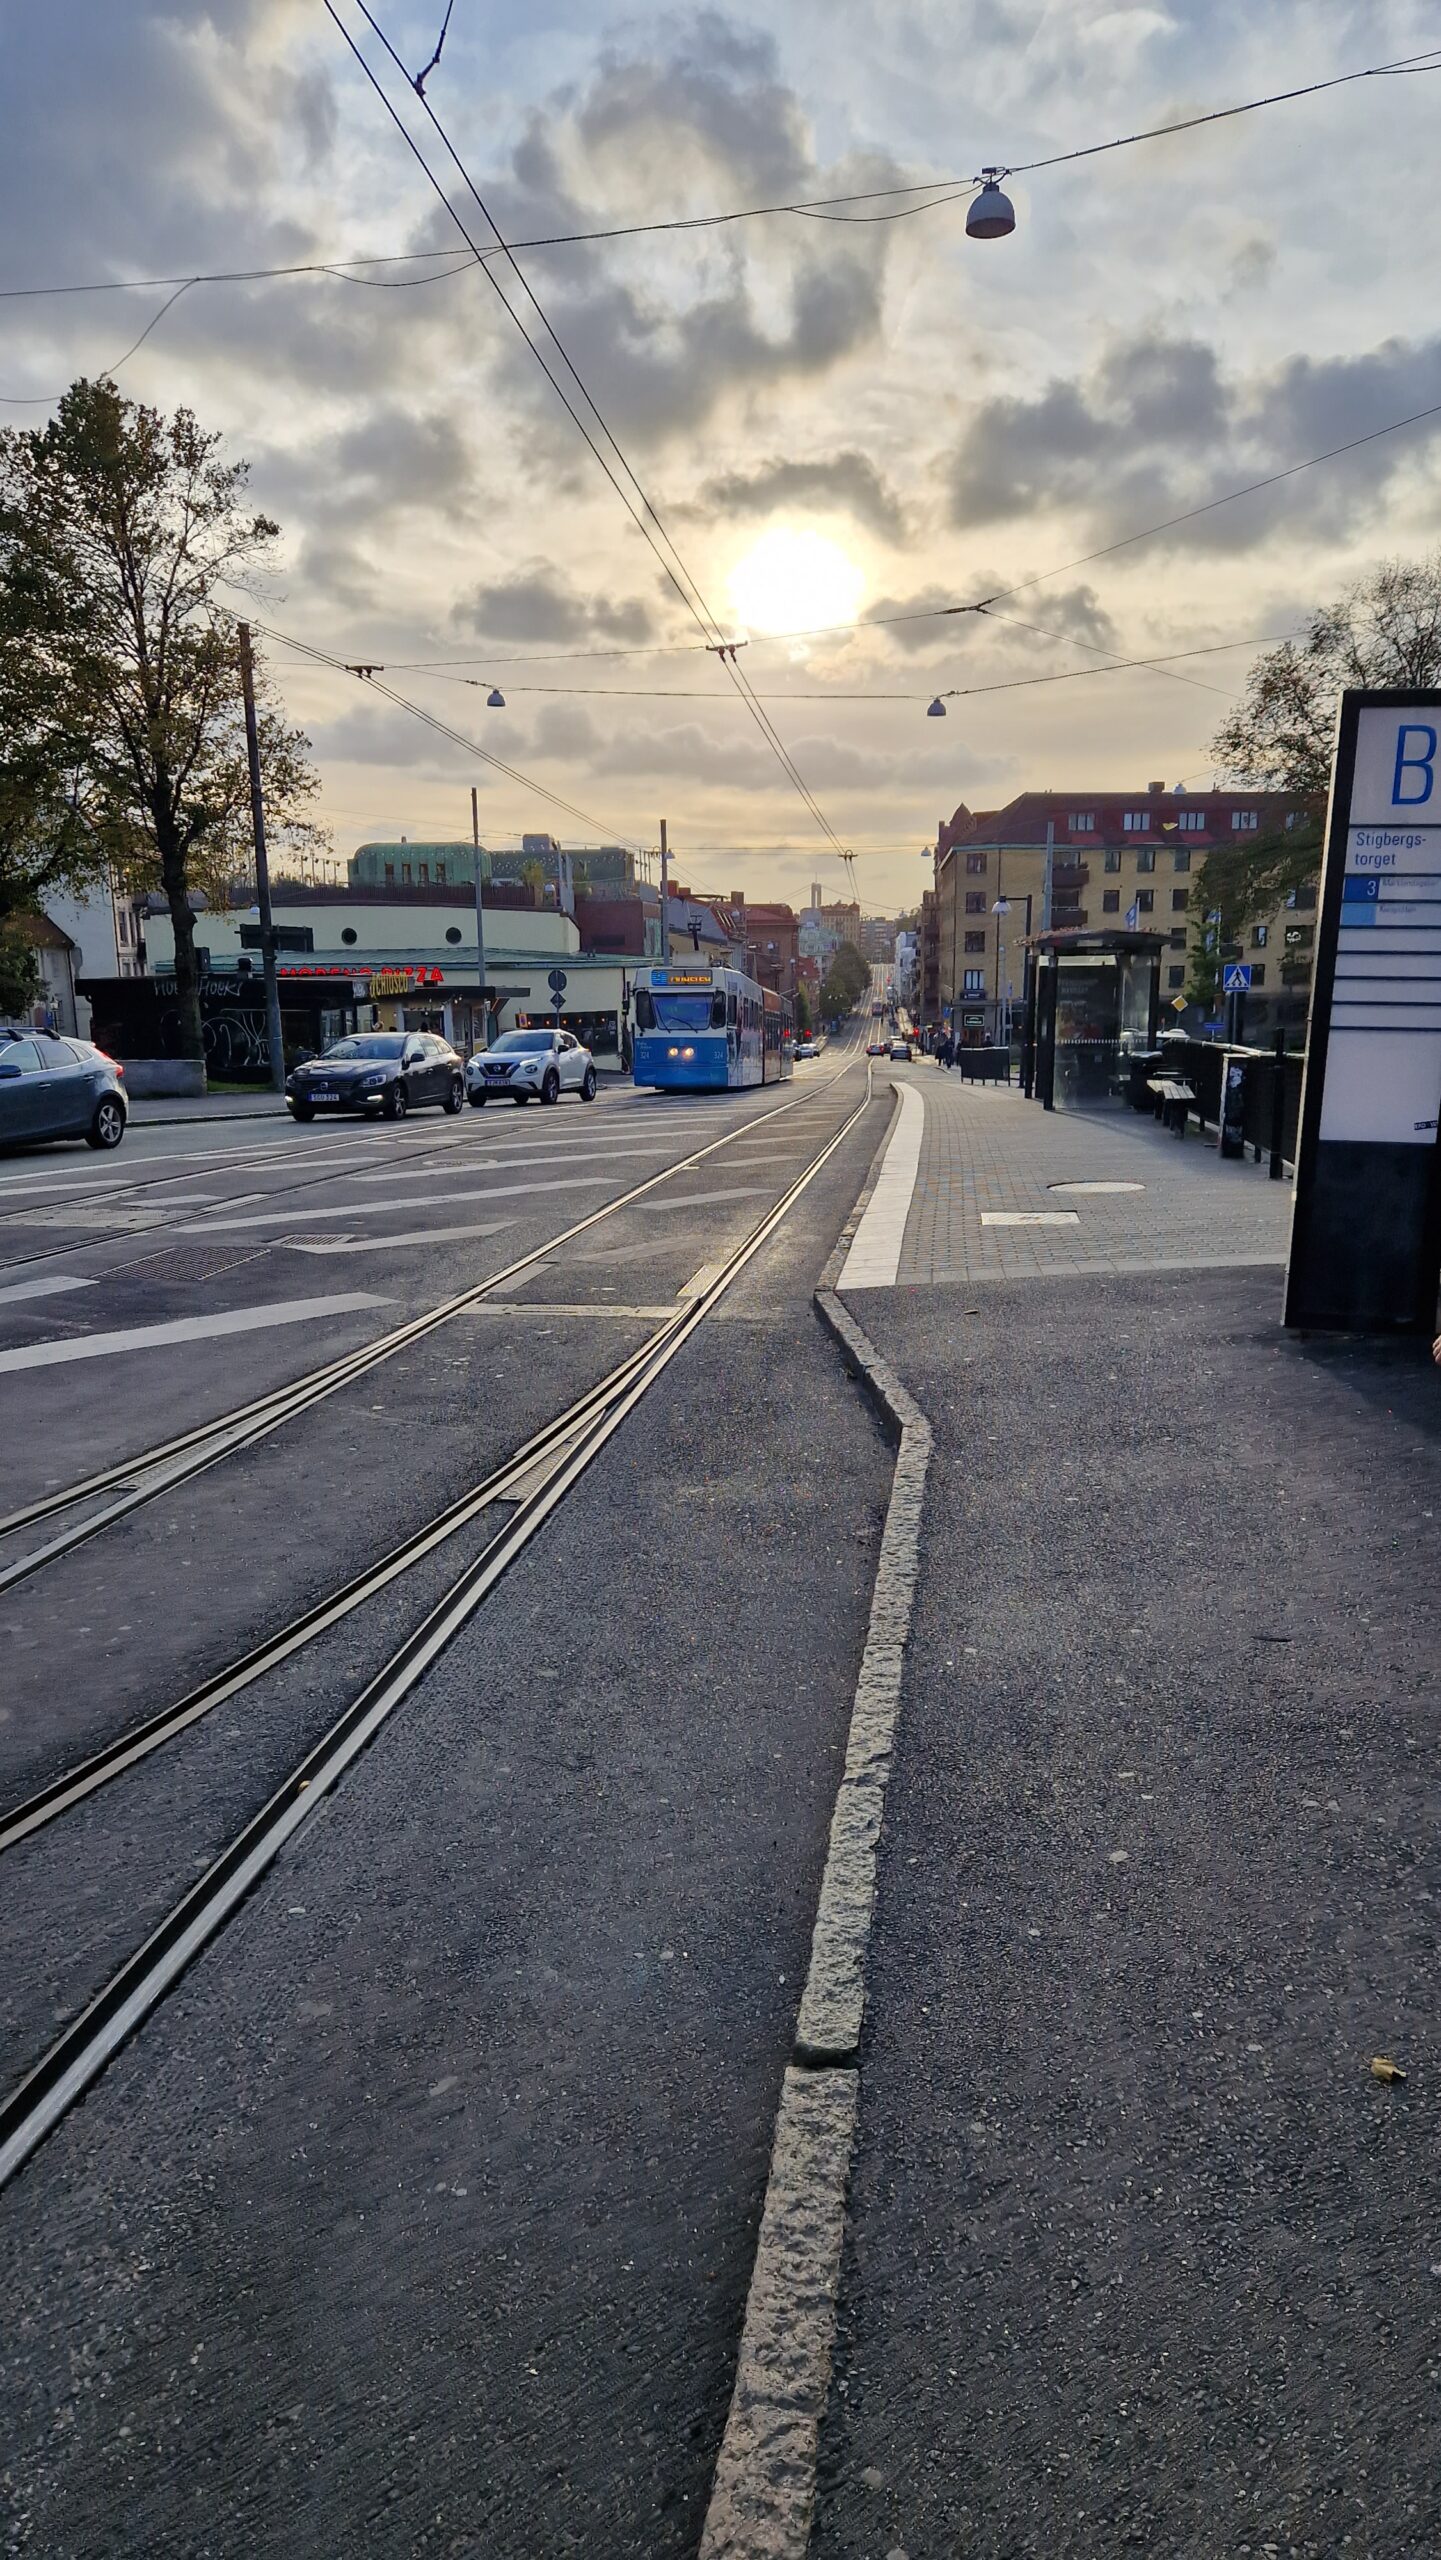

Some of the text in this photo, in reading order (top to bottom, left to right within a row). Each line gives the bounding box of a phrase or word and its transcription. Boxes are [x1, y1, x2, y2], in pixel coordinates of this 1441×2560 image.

[1391, 725, 1437, 805] B
[1356, 832, 1427, 849] Stigbergs-
[1354, 853, 1396, 868] torget
[1366, 880, 1377, 896] 3
